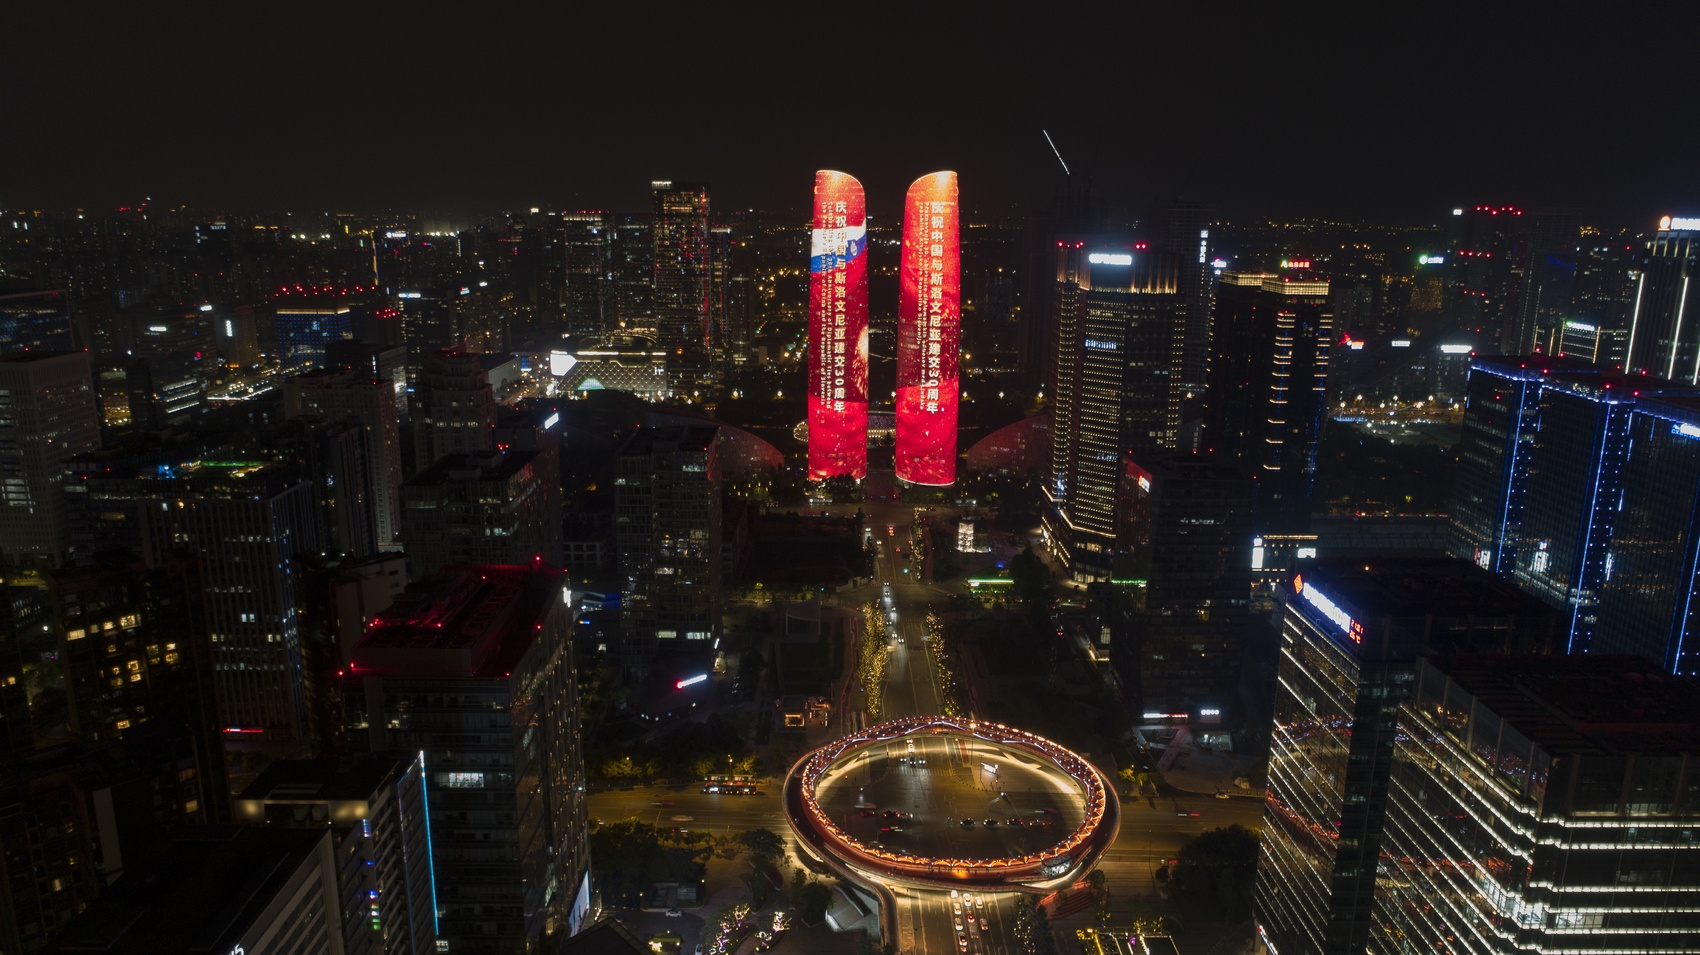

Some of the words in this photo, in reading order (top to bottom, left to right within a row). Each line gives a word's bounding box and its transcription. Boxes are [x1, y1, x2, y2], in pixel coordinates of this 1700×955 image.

[834, 201, 847, 413] 庆祝中国与斯洛文尼亚建交30周年
[926, 201, 944, 414] 庆祝中国与斯洛文尼亚建交30周年
